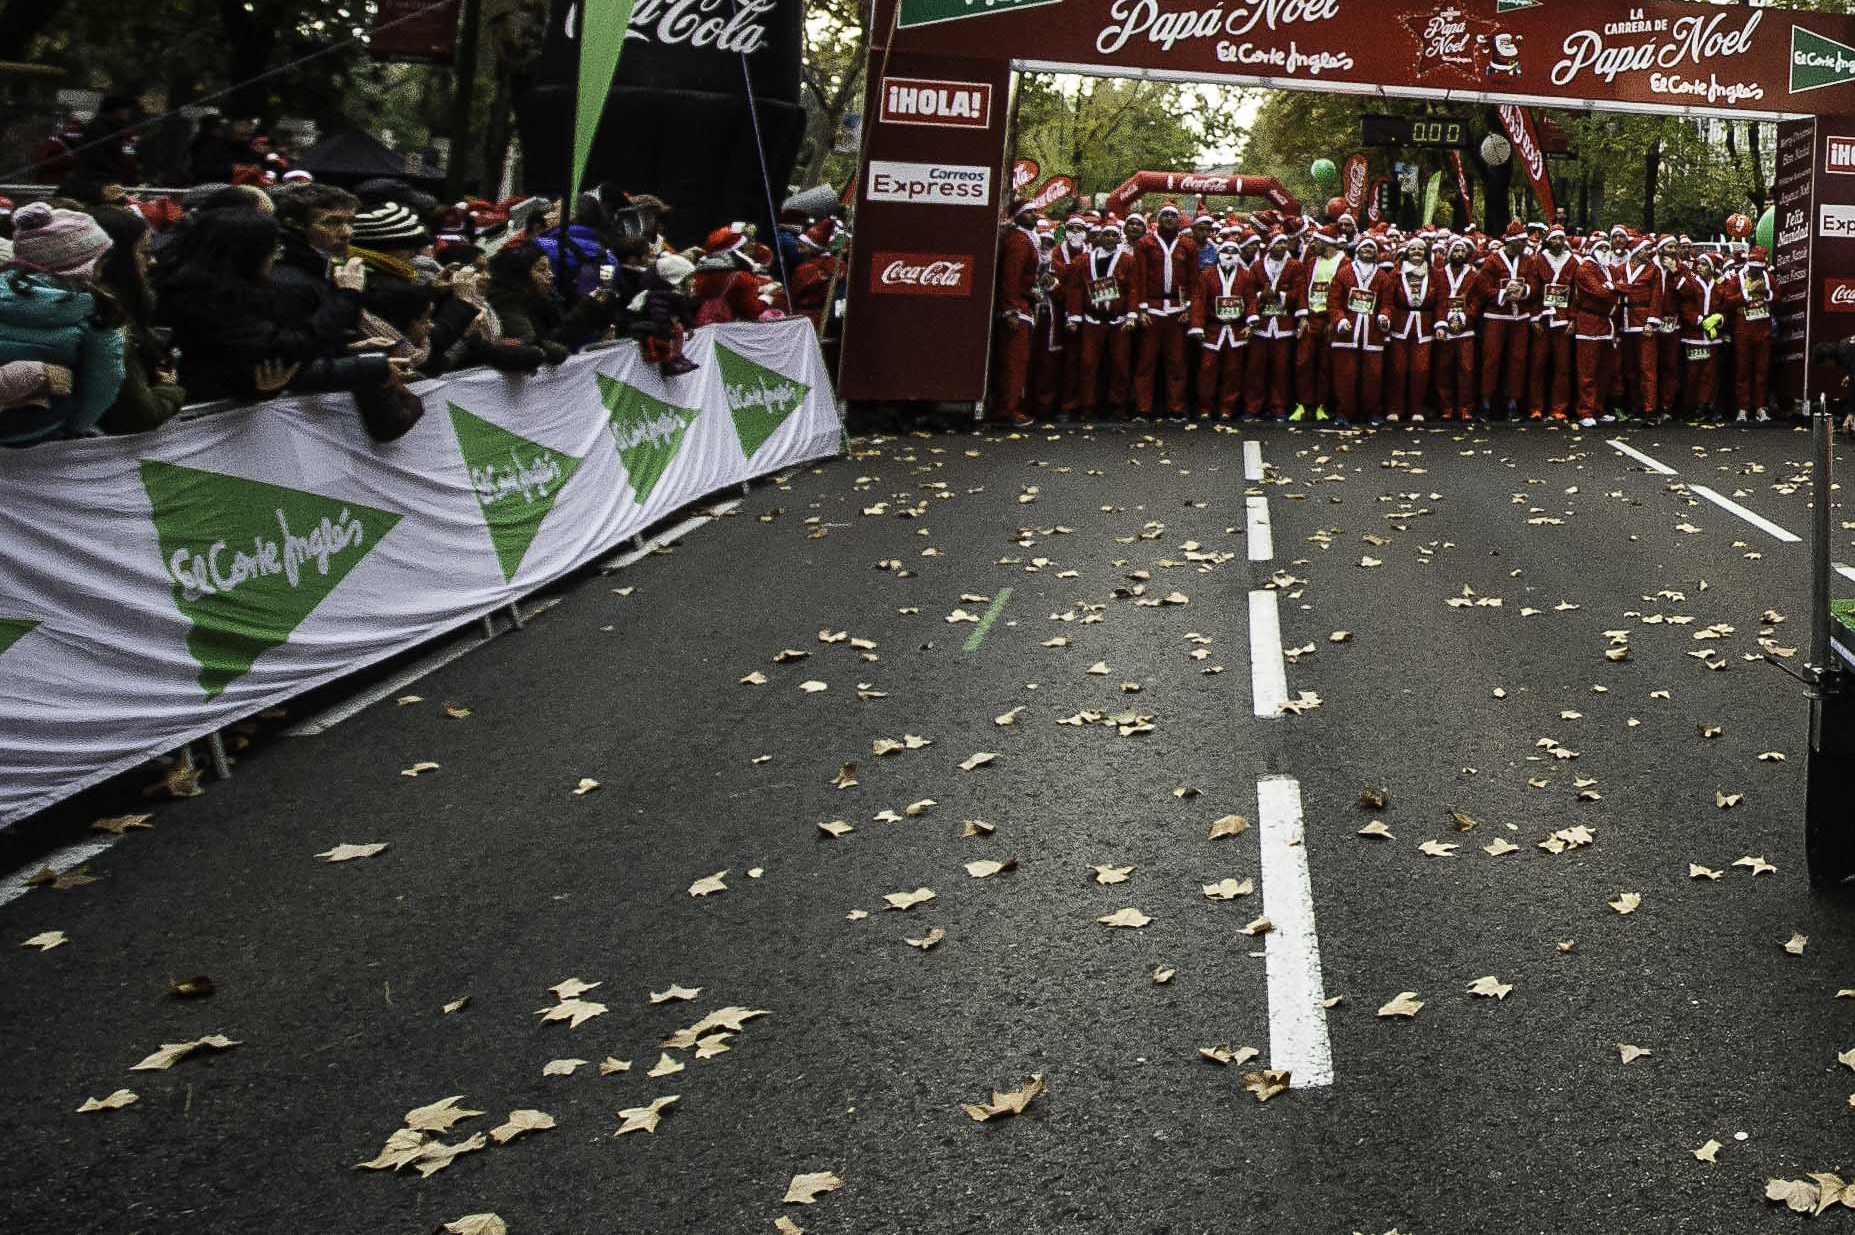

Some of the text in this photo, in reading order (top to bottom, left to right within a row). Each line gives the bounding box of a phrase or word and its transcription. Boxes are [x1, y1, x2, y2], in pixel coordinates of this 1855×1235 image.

[1630, 8, 1644, 20] LA
[1604, 19, 1668, 36] CARRERA DE
[1216, 40, 1354, 75] El Corte Inglés
[1425, 33, 1471, 58] Noel
[1551, 9, 1763, 86] Papá Noel
[1794, 50, 1807, 66] El
[1806, 52, 1835, 68] Corte
[1650, 72, 1764, 104] El Corte Inglés
[888, 85, 981, 119] ¡HOLA!
[873, 174, 984, 199] Express
[929, 168, 985, 182] Correos
[208, 536, 284, 591] Corte
[276, 508, 364, 588] Inglés
